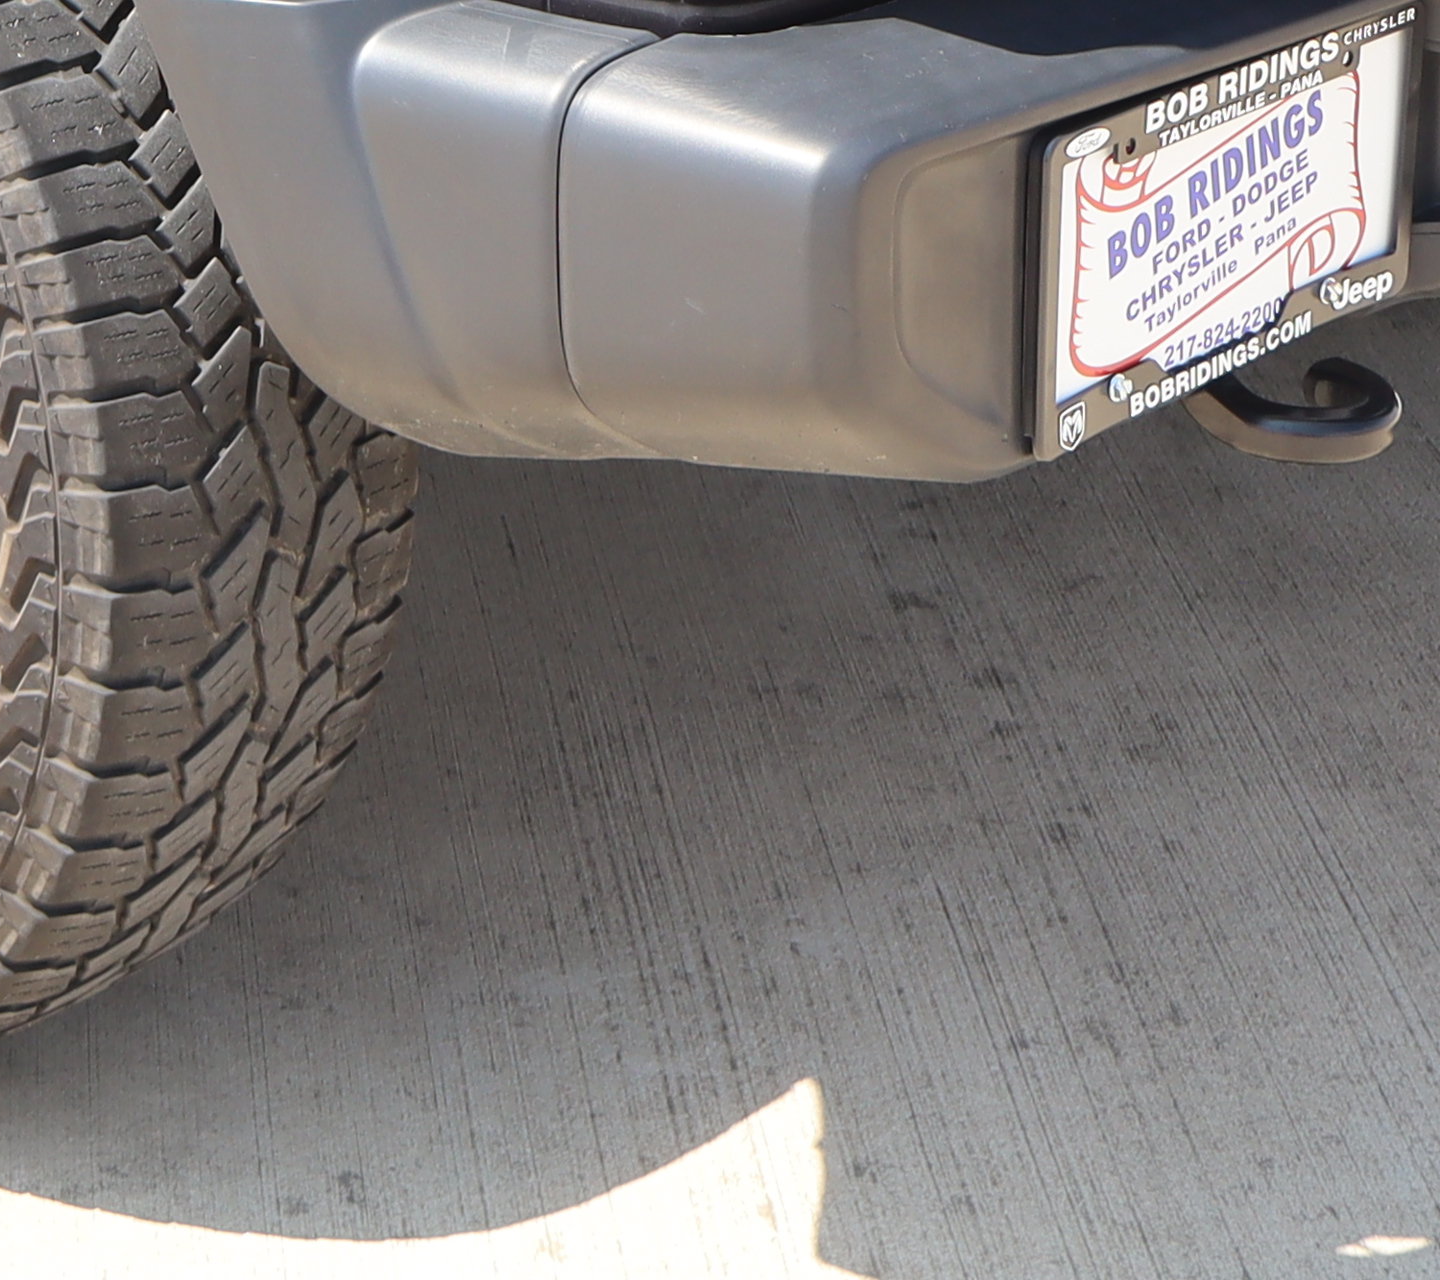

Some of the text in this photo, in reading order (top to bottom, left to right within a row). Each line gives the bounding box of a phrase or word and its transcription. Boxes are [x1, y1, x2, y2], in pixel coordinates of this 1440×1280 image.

[1343, 7, 1416, 46] CHRYSLER
[1145, 31, 1339, 134] BOB RIDINGS
[1159, 92, 1266, 146] TAYLORVILLE
[1280, 70, 1323, 97] PANA
[1107, 89, 1323, 279] BOB RIDINGS
[1152, 218, 1211, 275] FORD
[1232, 148, 1309, 217] DODGE
[1126, 223, 1243, 321] CHRYSLER
[1264, 171, 1318, 223] JEEP
[1144, 217, 1297, 332] Taylorville Pana
[1333, 267, 1394, 311] Jeep
[1129, 311, 1313, 418] BOBRIDINGS.COM
[1164, 296, 1285, 368] 217-824-2200
